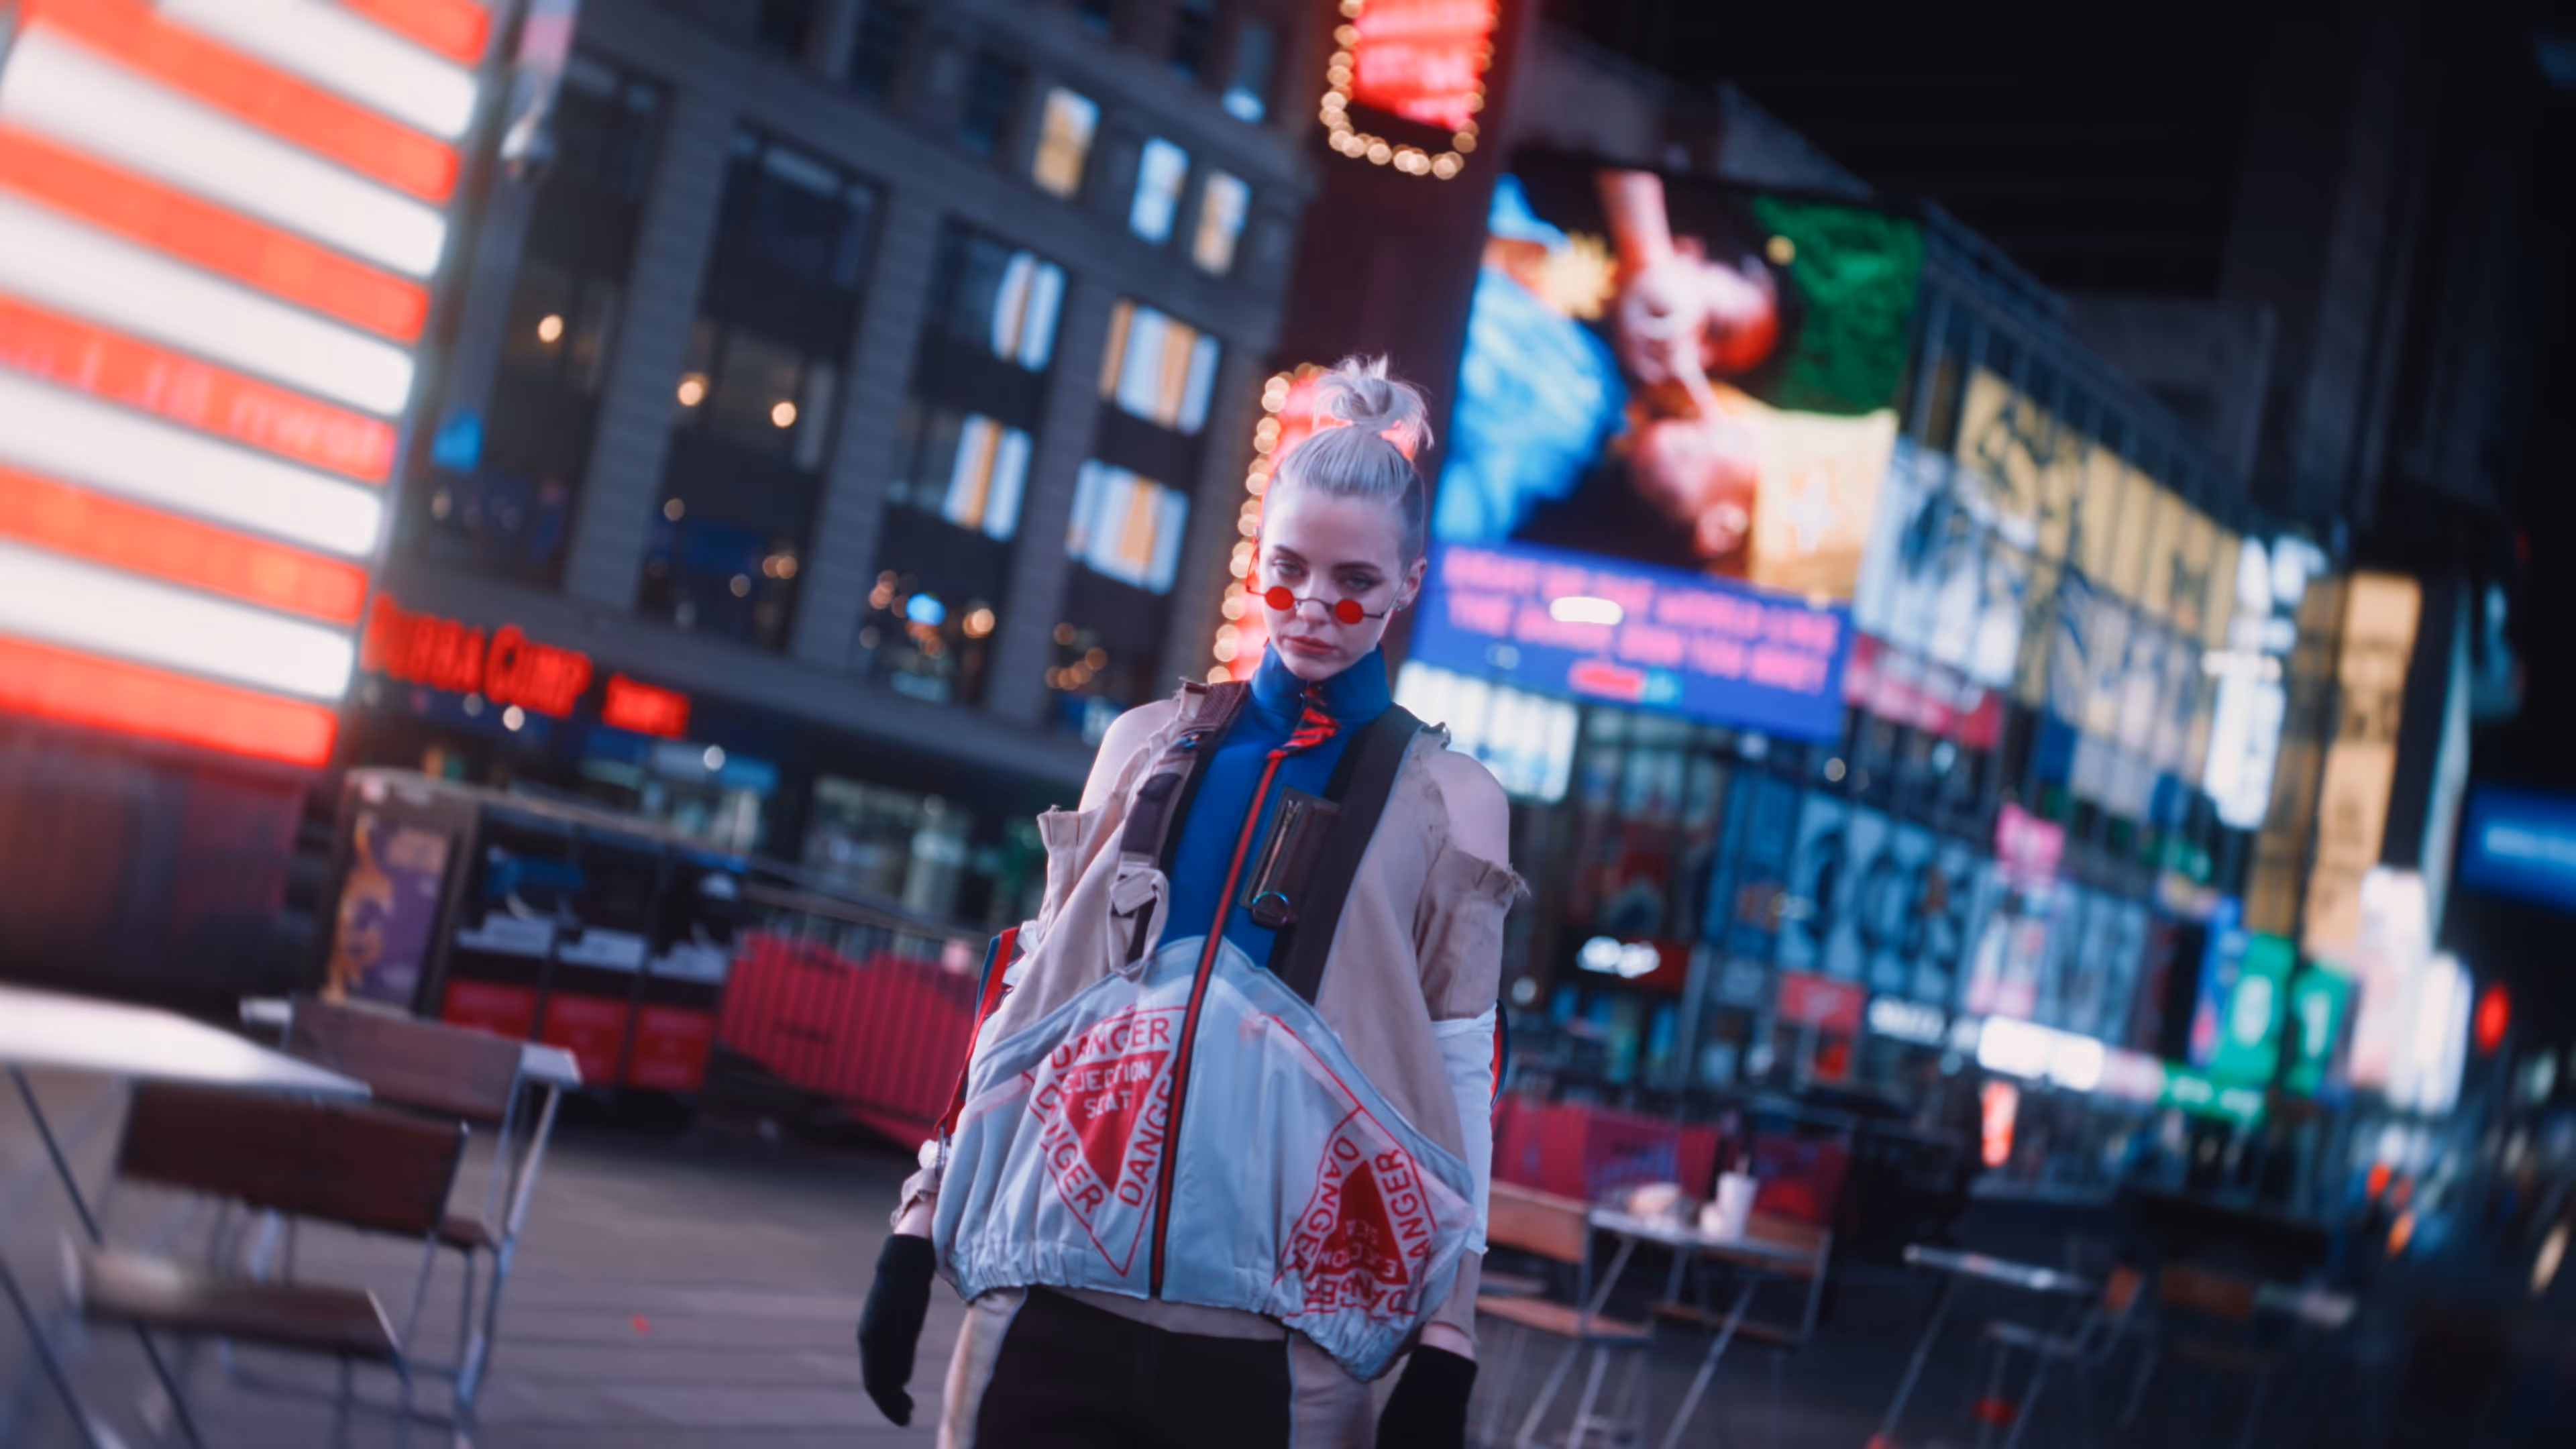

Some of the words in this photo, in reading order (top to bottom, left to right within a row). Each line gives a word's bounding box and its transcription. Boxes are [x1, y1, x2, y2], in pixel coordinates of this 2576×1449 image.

[1051, 1017, 1170, 1069] DANGER
[1035, 1083, 1104, 1214] DNGER
[1118, 1077, 1171, 1208] DANGE
[1285, 1136, 1360, 1271] DANGER
[1375, 1148, 1432, 1258] ANGER
